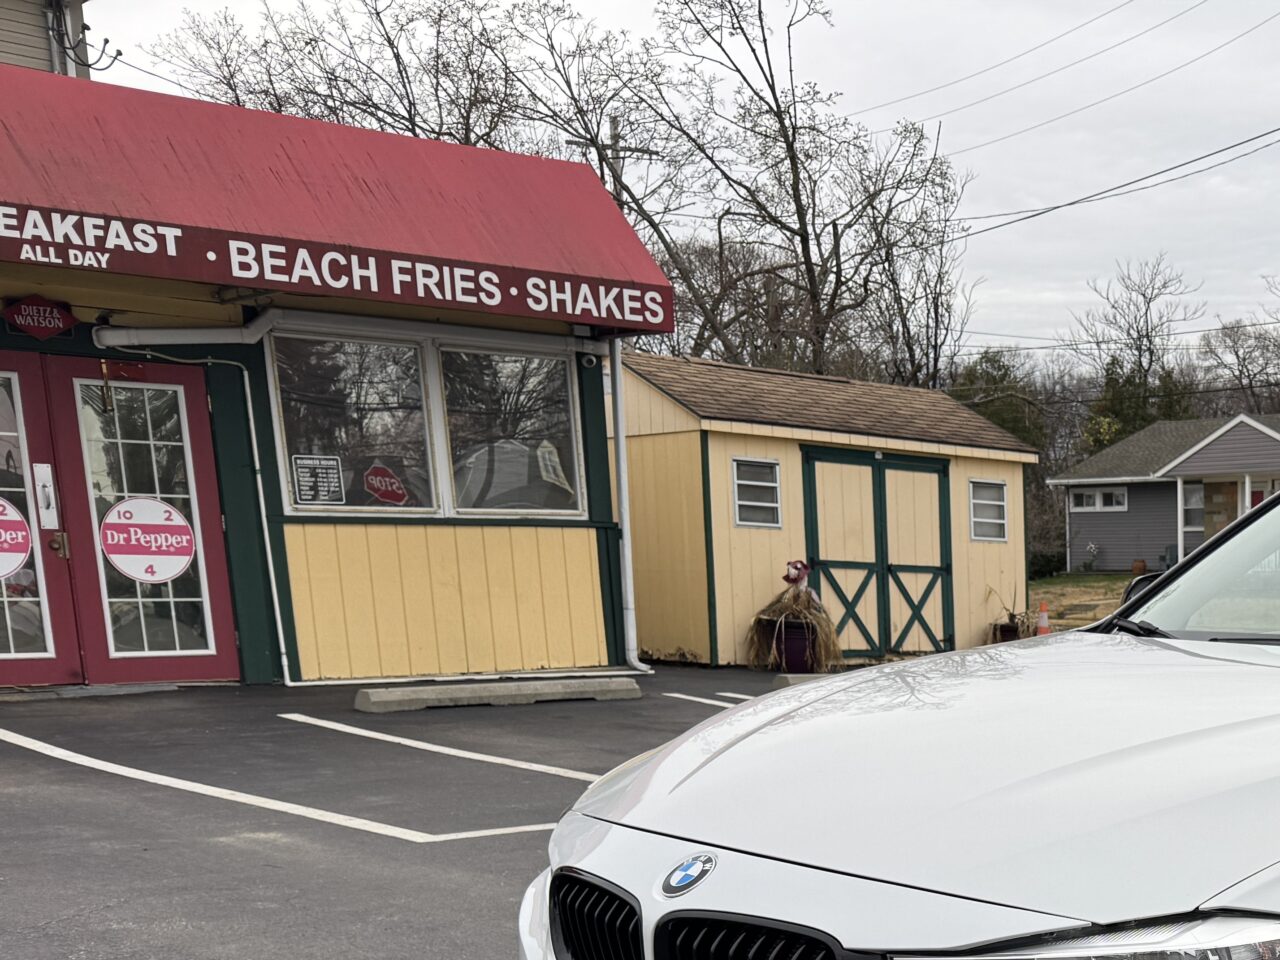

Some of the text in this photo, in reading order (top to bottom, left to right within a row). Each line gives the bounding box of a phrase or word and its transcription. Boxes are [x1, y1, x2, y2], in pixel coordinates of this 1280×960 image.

[0, 206, 665, 324] EAKFAST BEACH FRIES SHAKES
[20, 244, 110, 269] ALL DAY
[14, 314, 64, 329] WATSON
[117, 509, 174, 522] 10 2
[105, 527, 191, 552] Dr Pepper
[144, 564, 157, 577] 4
